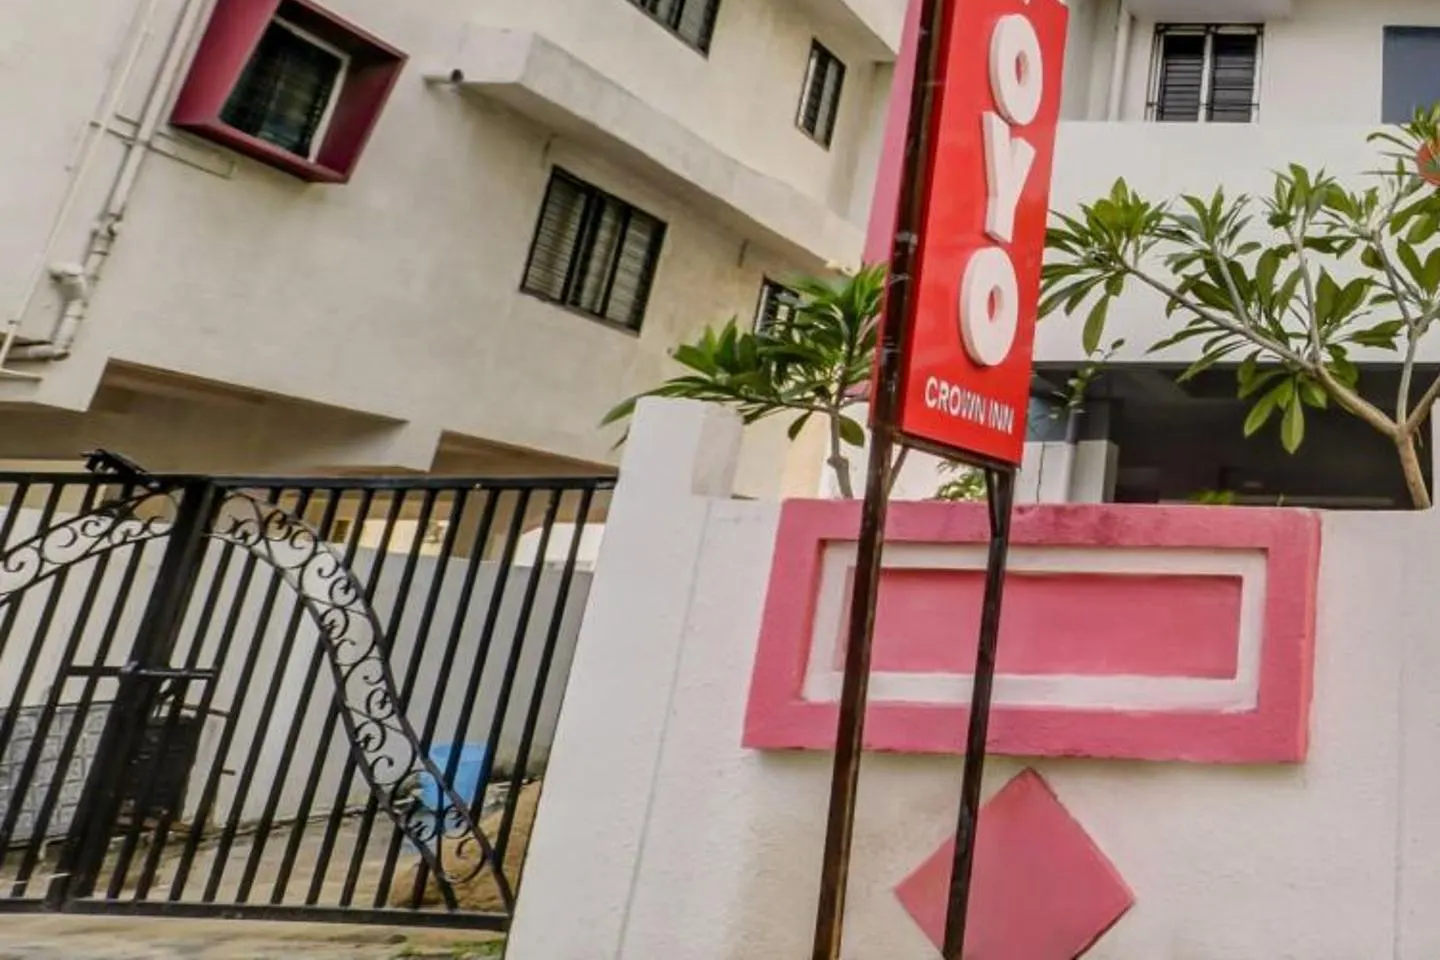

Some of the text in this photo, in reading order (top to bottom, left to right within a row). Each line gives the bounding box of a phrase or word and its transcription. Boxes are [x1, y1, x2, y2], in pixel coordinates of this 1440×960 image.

[959, 13, 1044, 367] OYO
[924, 375, 1015, 435] CROWN INN
